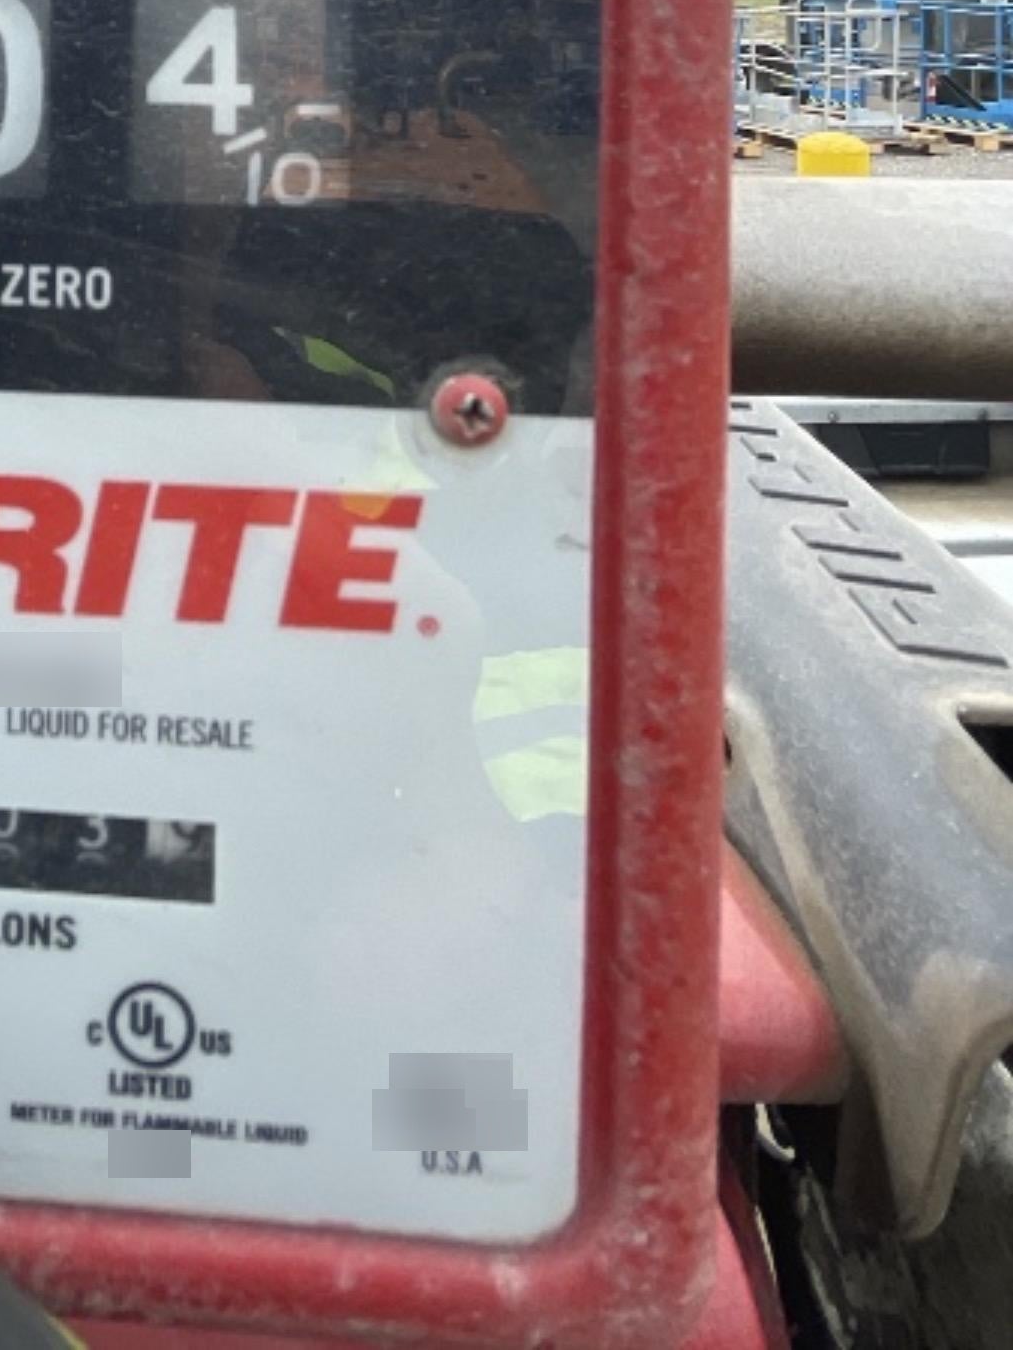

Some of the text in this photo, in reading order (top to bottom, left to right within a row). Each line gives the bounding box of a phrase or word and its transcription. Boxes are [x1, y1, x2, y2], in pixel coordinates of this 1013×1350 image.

[0, 263, 113, 310] ZERO
[6, 707, 89, 739] LIQUID
[97, 710, 147, 744] FOR
[156, 715, 254, 751] RESALE
[199, 1030, 232, 1056] US
[108, 1071, 193, 1099] LISTED
